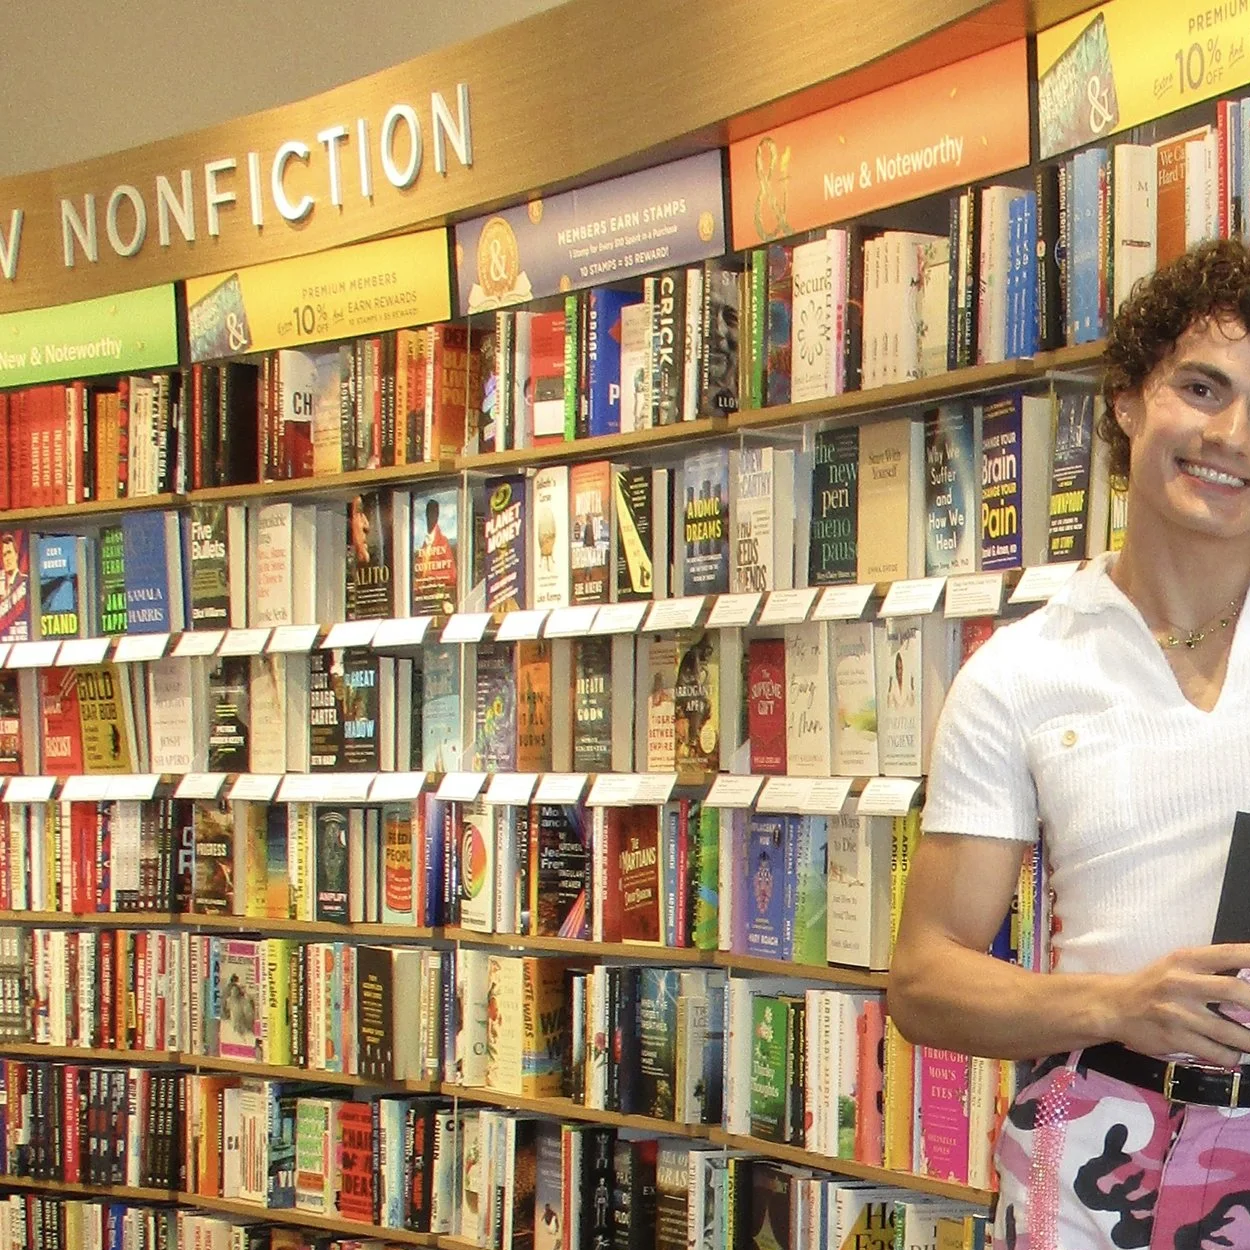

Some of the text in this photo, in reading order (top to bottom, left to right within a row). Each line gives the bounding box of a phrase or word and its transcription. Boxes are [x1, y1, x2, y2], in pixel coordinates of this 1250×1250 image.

[1188, 2, 1249, 33] PREMIUM
[1206, 68, 1224, 86] OFF
[60, 83, 473, 267] NONFICTION
[823, 134, 964, 200] New & Noteworthy
[1158, 169, 1179, 186] Hard
[557, 221, 607, 245] MEMBERS
[610, 210, 639, 227] EARN
[643, 199, 686, 223] STAMPS
[350, 271, 398, 291] MEMBERS
[348, 299, 373, 313] EARN
[374, 290, 418, 310] REWARDS
[659, 276, 674, 366] CRICK
[45, 335, 123, 364] Noteworthy
[816, 436, 835, 463] the
[1000, 432, 1017, 446] YOUR
[927, 443, 960, 465] Why We
[829, 463, 857, 485] new
[930, 467, 956, 486] Suffer
[982, 448, 1017, 485] Brain
[822, 484, 850, 518] peri
[935, 488, 952, 507] and
[813, 517, 851, 537] meno
[928, 509, 964, 531] How We
[981, 498, 1017, 541] Pain
[192, 521, 213, 541] Five
[686, 520, 722, 543] DREAMS
[935, 531, 957, 551] Heal
[192, 540, 226, 560] Bullets
[355, 565, 390, 586] ALITO
[40, 613, 78, 636] STAND
[78, 672, 115, 702] GOLD
[82, 702, 118, 721] BAR BOB
[757, 700, 775, 716] GIFT
[924, 1045, 965, 1064] THROUGH
[928, 1067, 957, 1082] MOM'S
[931, 1086, 954, 1100] EYES
